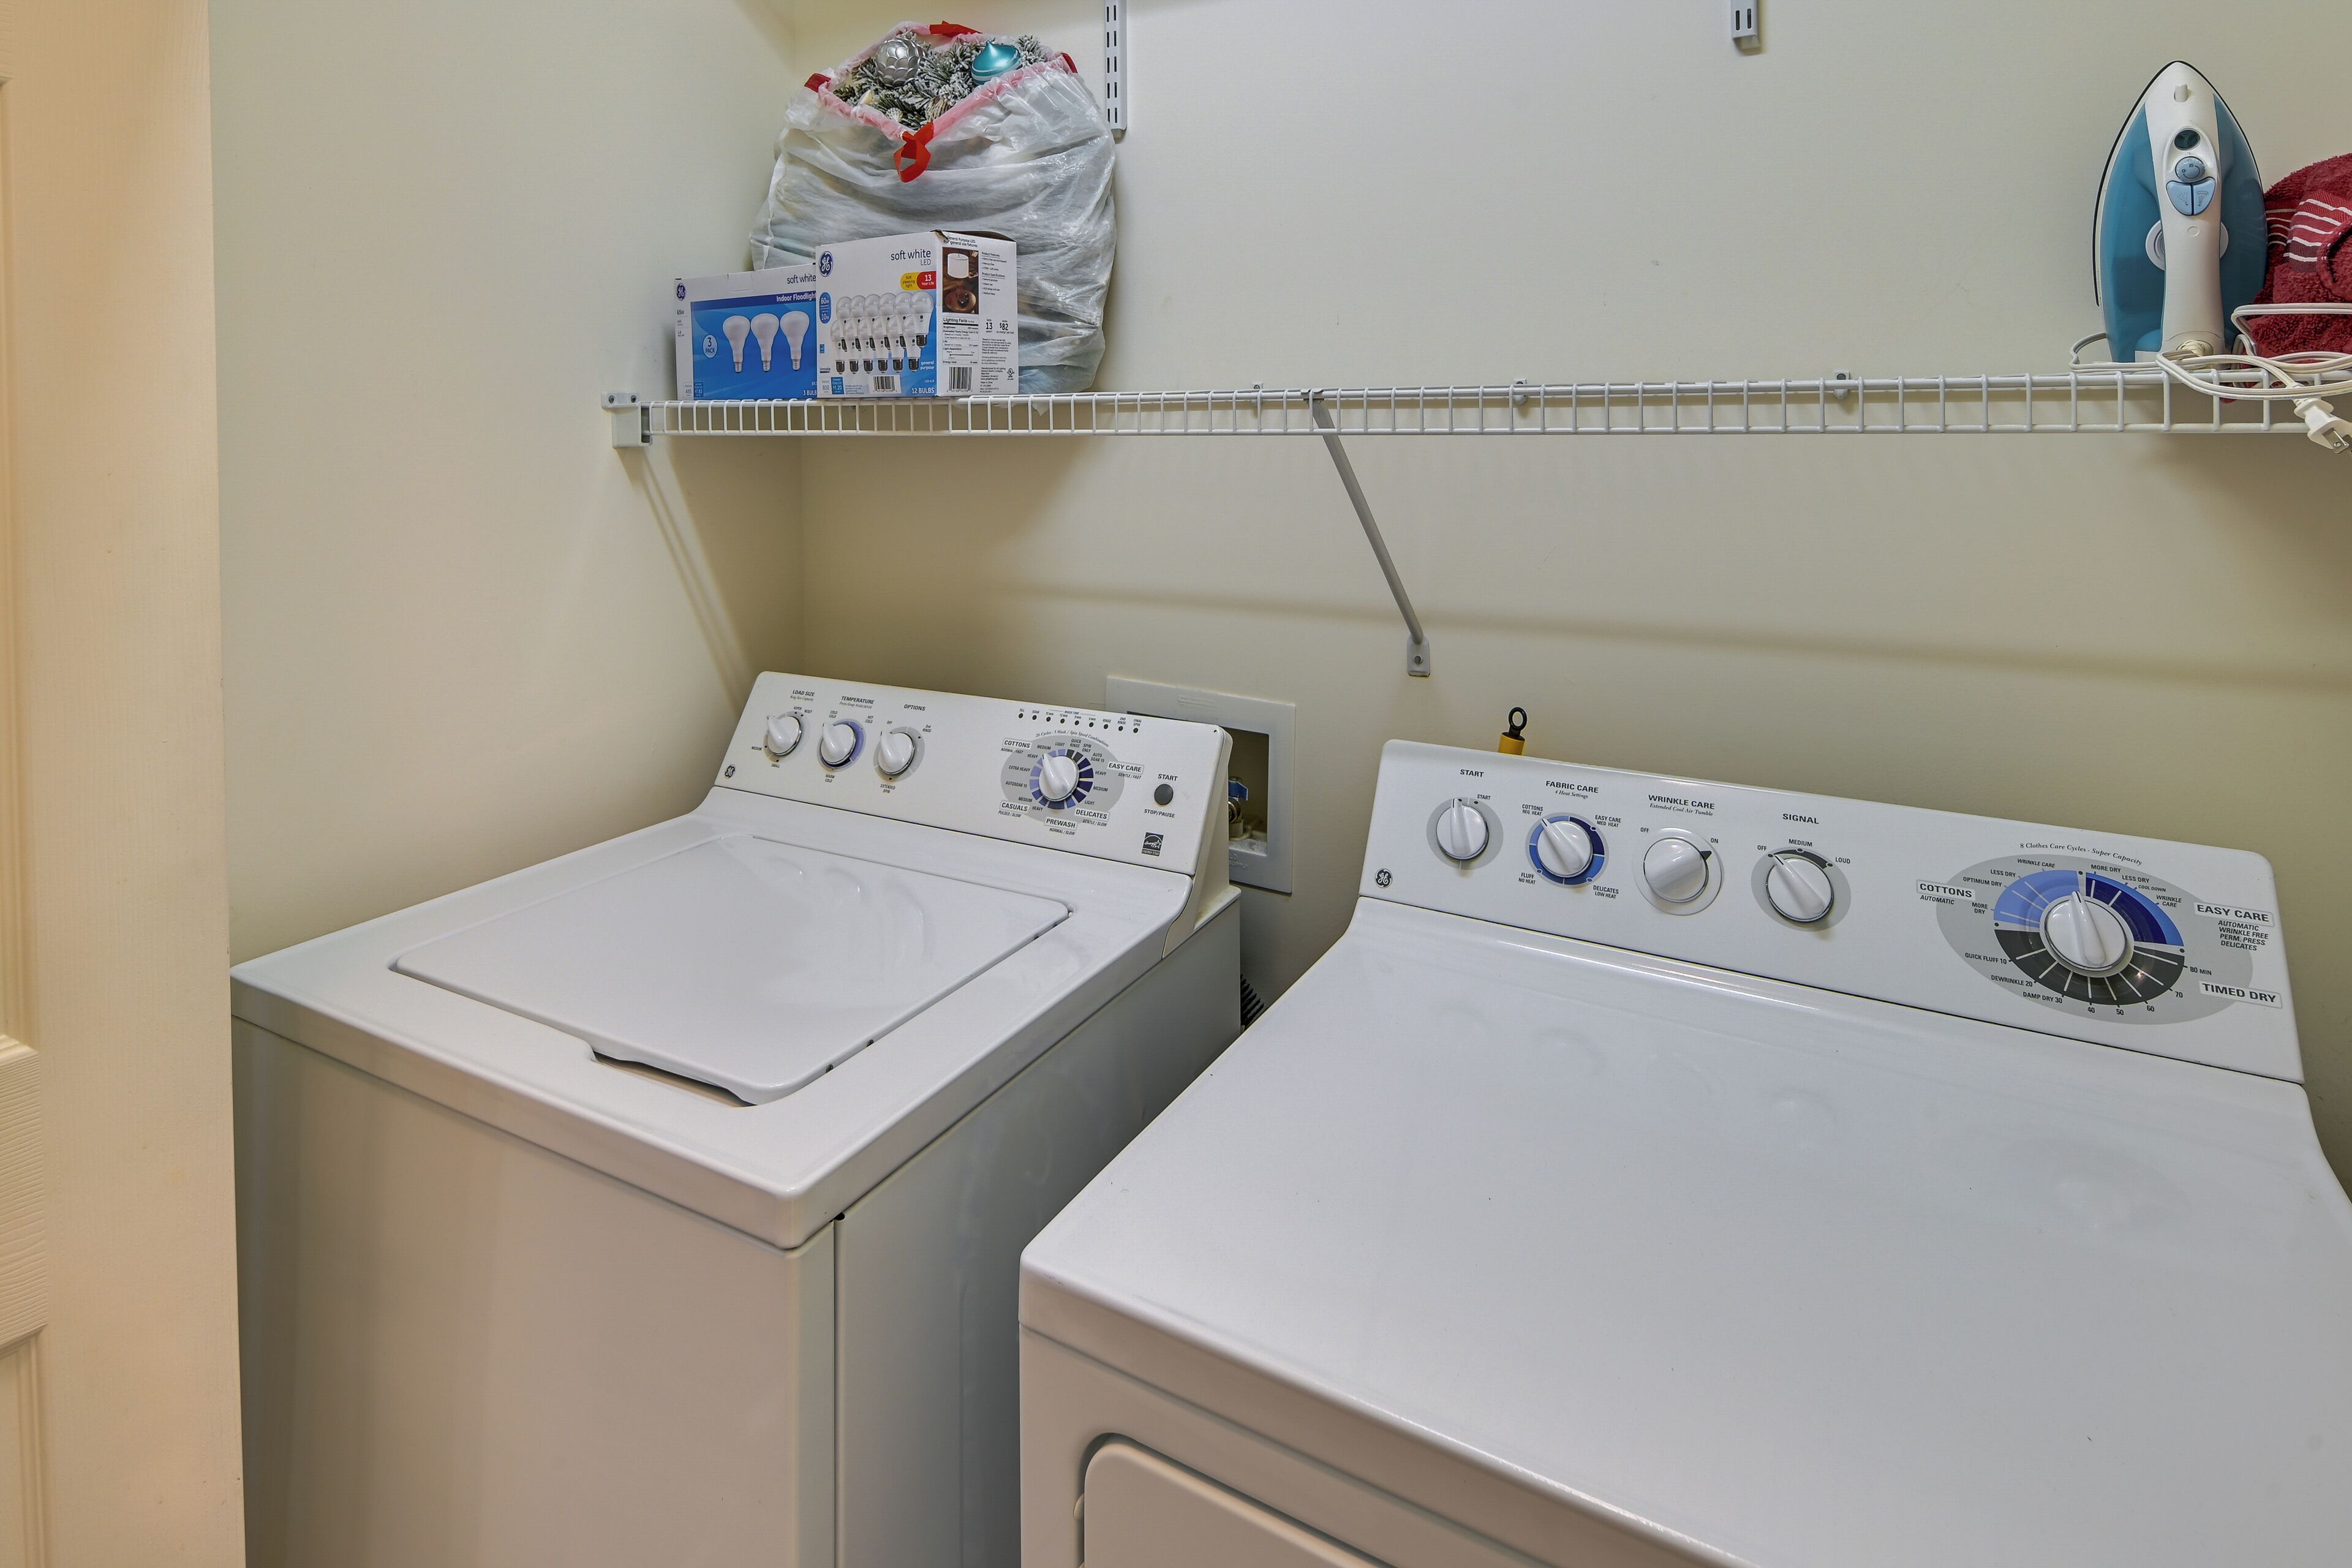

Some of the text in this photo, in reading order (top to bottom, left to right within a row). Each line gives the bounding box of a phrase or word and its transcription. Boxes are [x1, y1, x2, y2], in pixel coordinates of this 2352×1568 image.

[891, 249, 931, 261] soft white
[787, 273, 816, 284] soft white
[707, 337, 712, 347] 3
[841, 696, 874, 704] TEMPERATURE
[1004, 740, 1031, 748] COTTONS
[1460, 769, 1484, 778] START
[1546, 780, 1599, 793] FABRIC CARE
[1001, 802, 1028, 812] CASUALS
[1648, 795, 1715, 810] WRINKLE CARE
[1076, 809, 1107, 820] DELICATES
[1144, 809, 1175, 818] STOP/PAUSE
[1782, 813, 1820, 824] SIGNAL
[1046, 818, 1076, 828] PREWASH
[1788, 839, 1813, 847] MEDIUM
[2091, 848, 2111, 857] Super
[2113, 852, 2143, 866] Capacity
[1374, 868, 1393, 888] GE
[1963, 876, 1990, 885] OPTIMUM
[1593, 885, 1619, 894] DELICATES
[1920, 883, 1972, 898] COTTONS
[1920, 895, 1955, 905] AUTOMATIC
[2156, 895, 2182, 903] WRINKLE
[2197, 904, 2269, 922] EASY CARE
[2218, 920, 2259, 931] AUTOMATIC
[2219, 927, 2251, 937] WRINKLE
[2220, 933, 2265, 946] PERM. PRESS
[2220, 940, 2258, 951] DELICATES
[1965, 952, 1982, 960] QUICK
[1991, 975, 2024, 986] DEWRINKLE
[2023, 991, 2041, 1000] DAMP
[2202, 983, 2276, 1003] TIMED DRY
